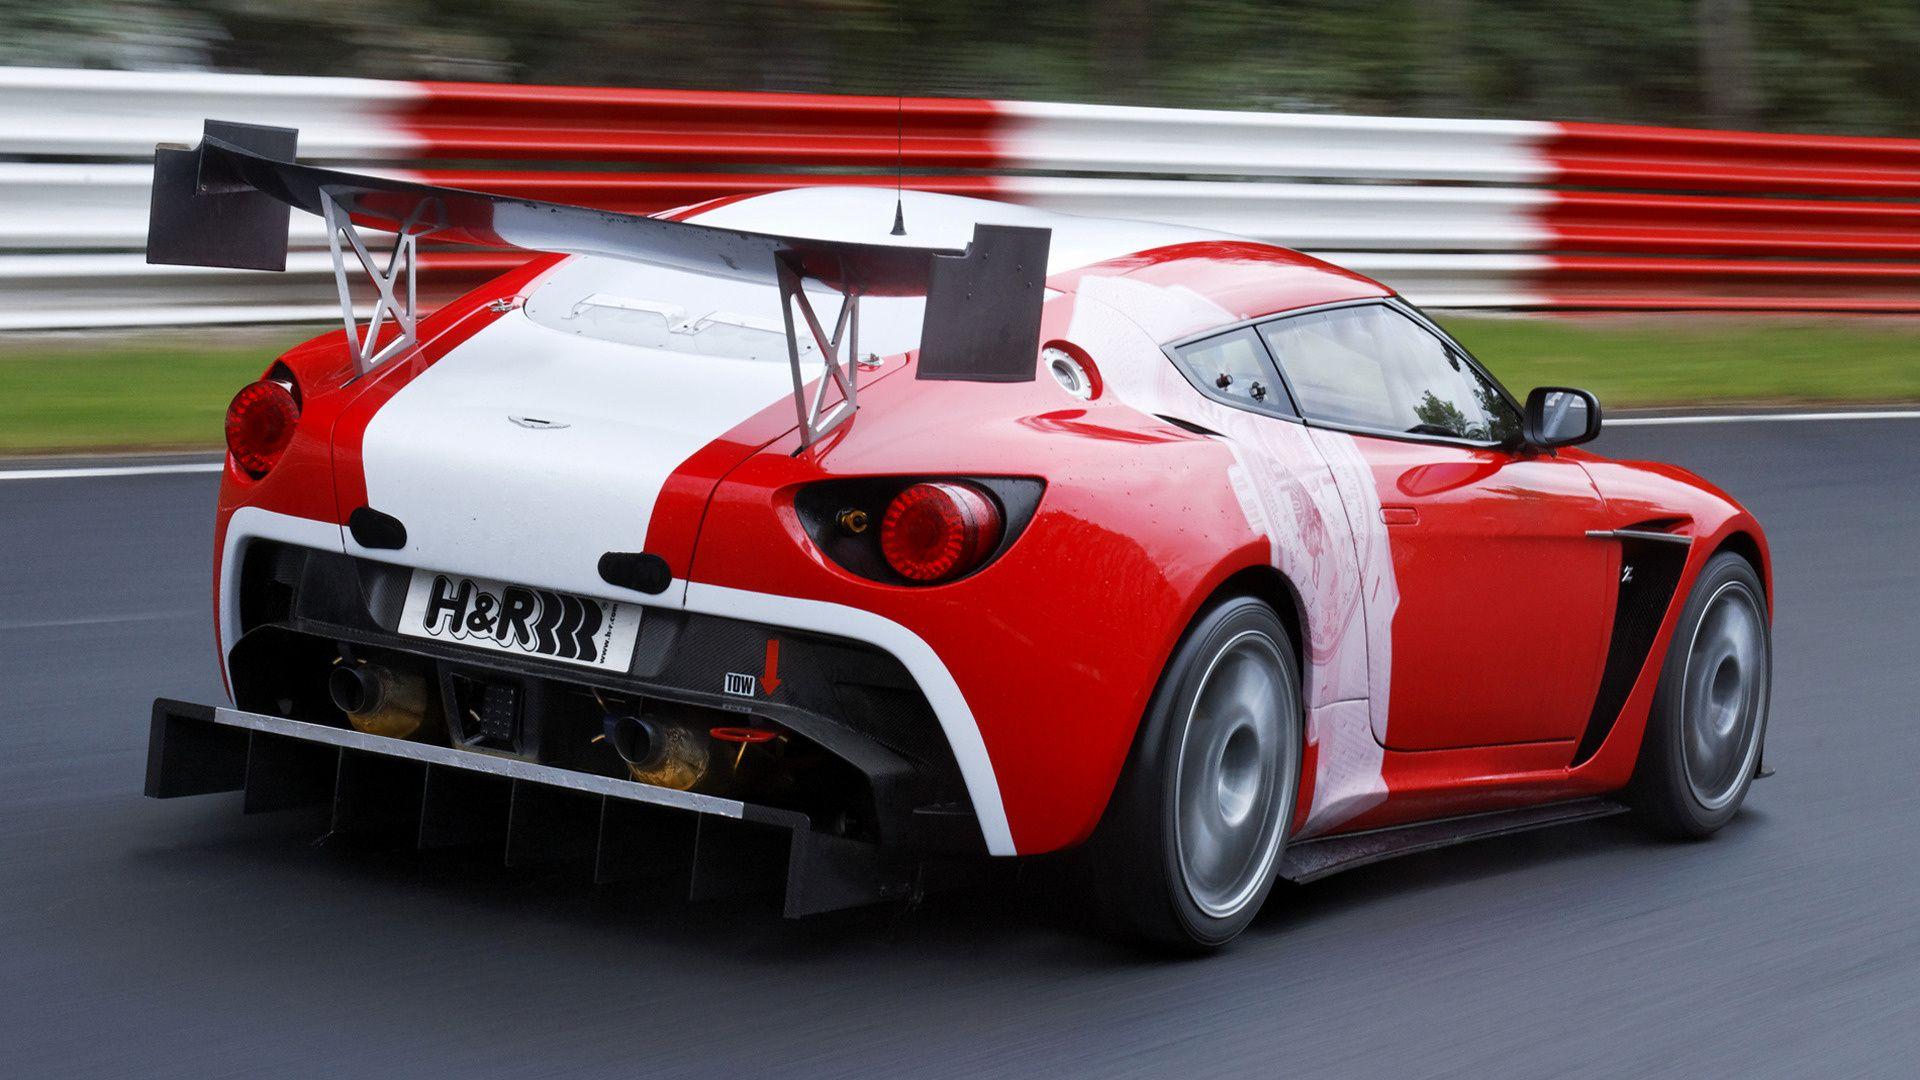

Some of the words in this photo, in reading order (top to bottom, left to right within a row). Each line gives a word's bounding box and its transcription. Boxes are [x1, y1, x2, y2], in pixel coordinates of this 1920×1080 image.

[423, 575, 543, 652] H&R
[600, 603, 618, 664] www.h-r.com
[726, 674, 754, 695] TOW
